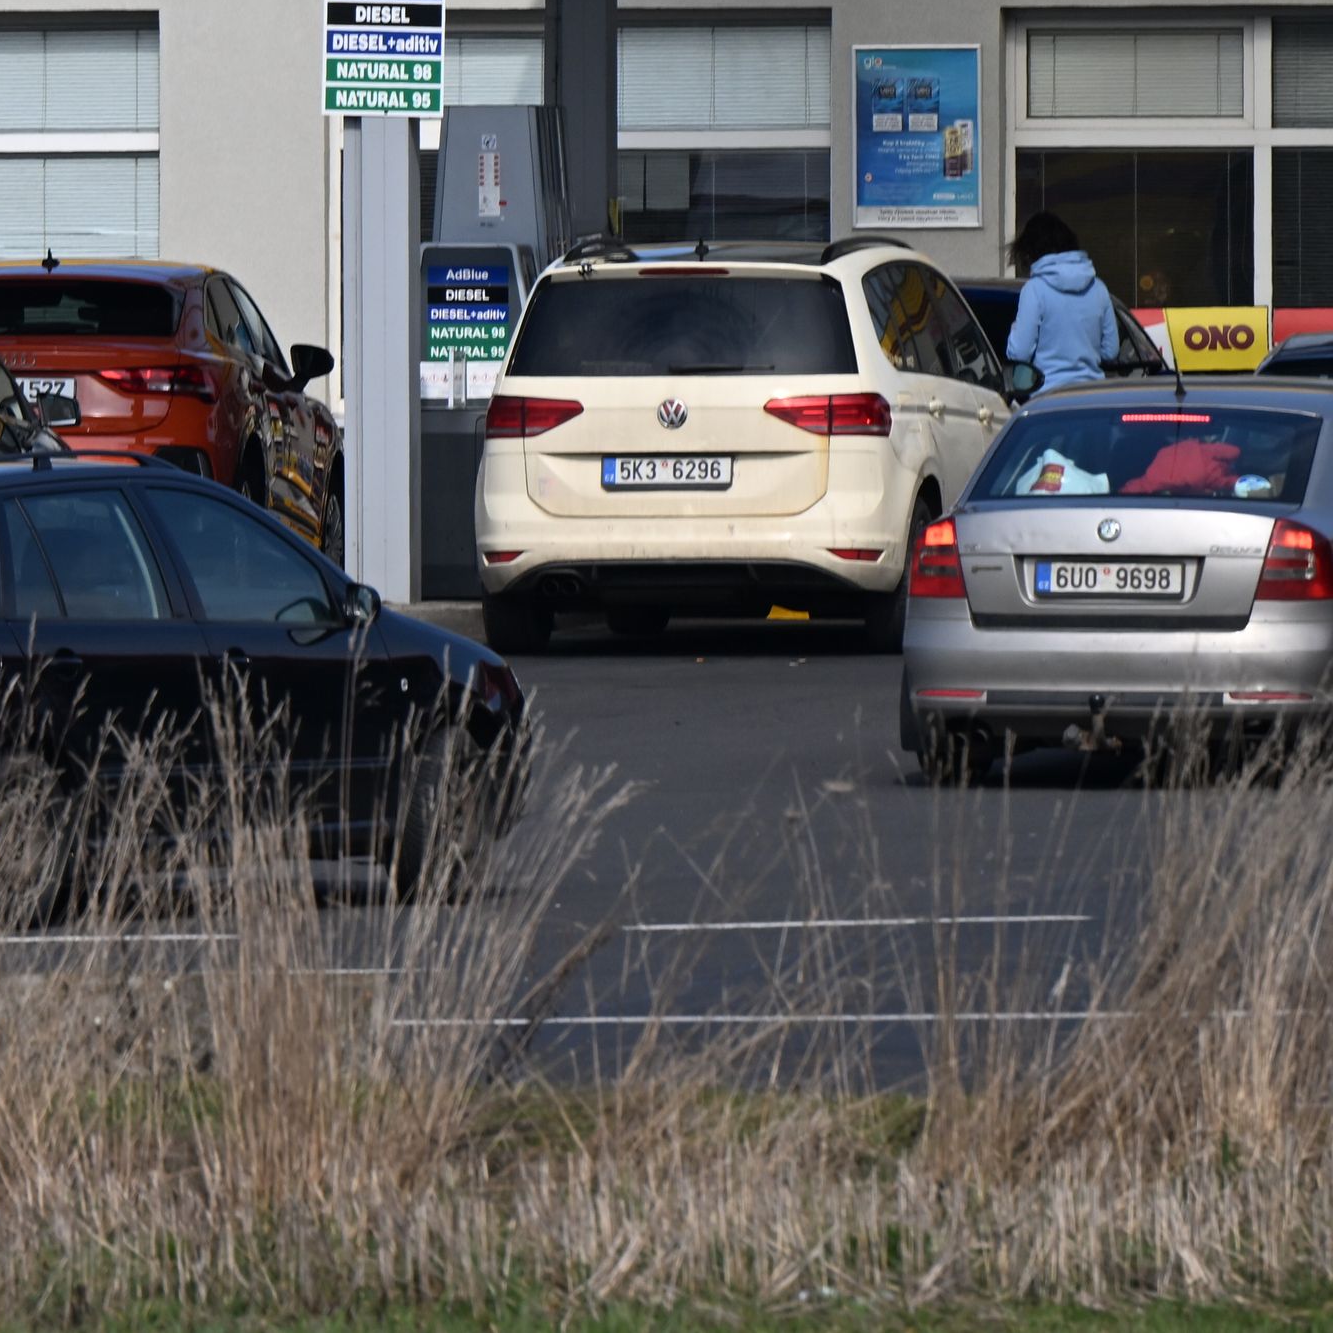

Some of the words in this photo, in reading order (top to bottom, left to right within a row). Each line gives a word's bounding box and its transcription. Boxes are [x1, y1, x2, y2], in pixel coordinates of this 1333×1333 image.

[355, 6, 410, 24] DIESEL
[336, 62, 409, 80] NATURAL
[413, 63, 432, 81] 98
[335, 90, 408, 108] NATURAL
[412, 91, 431, 109] 95
[446, 269, 489, 281] AdBlue
[445, 289, 490, 302] DIESEL
[431, 327, 489, 339] NATURAL
[491, 327, 506, 339] 98
[1184, 324, 1255, 351] ONO
[490, 346, 505, 358] 95
[620, 459, 657, 480] 5K3
[672, 460, 721, 480] 6296
[1115, 567, 1171, 590] 9698
